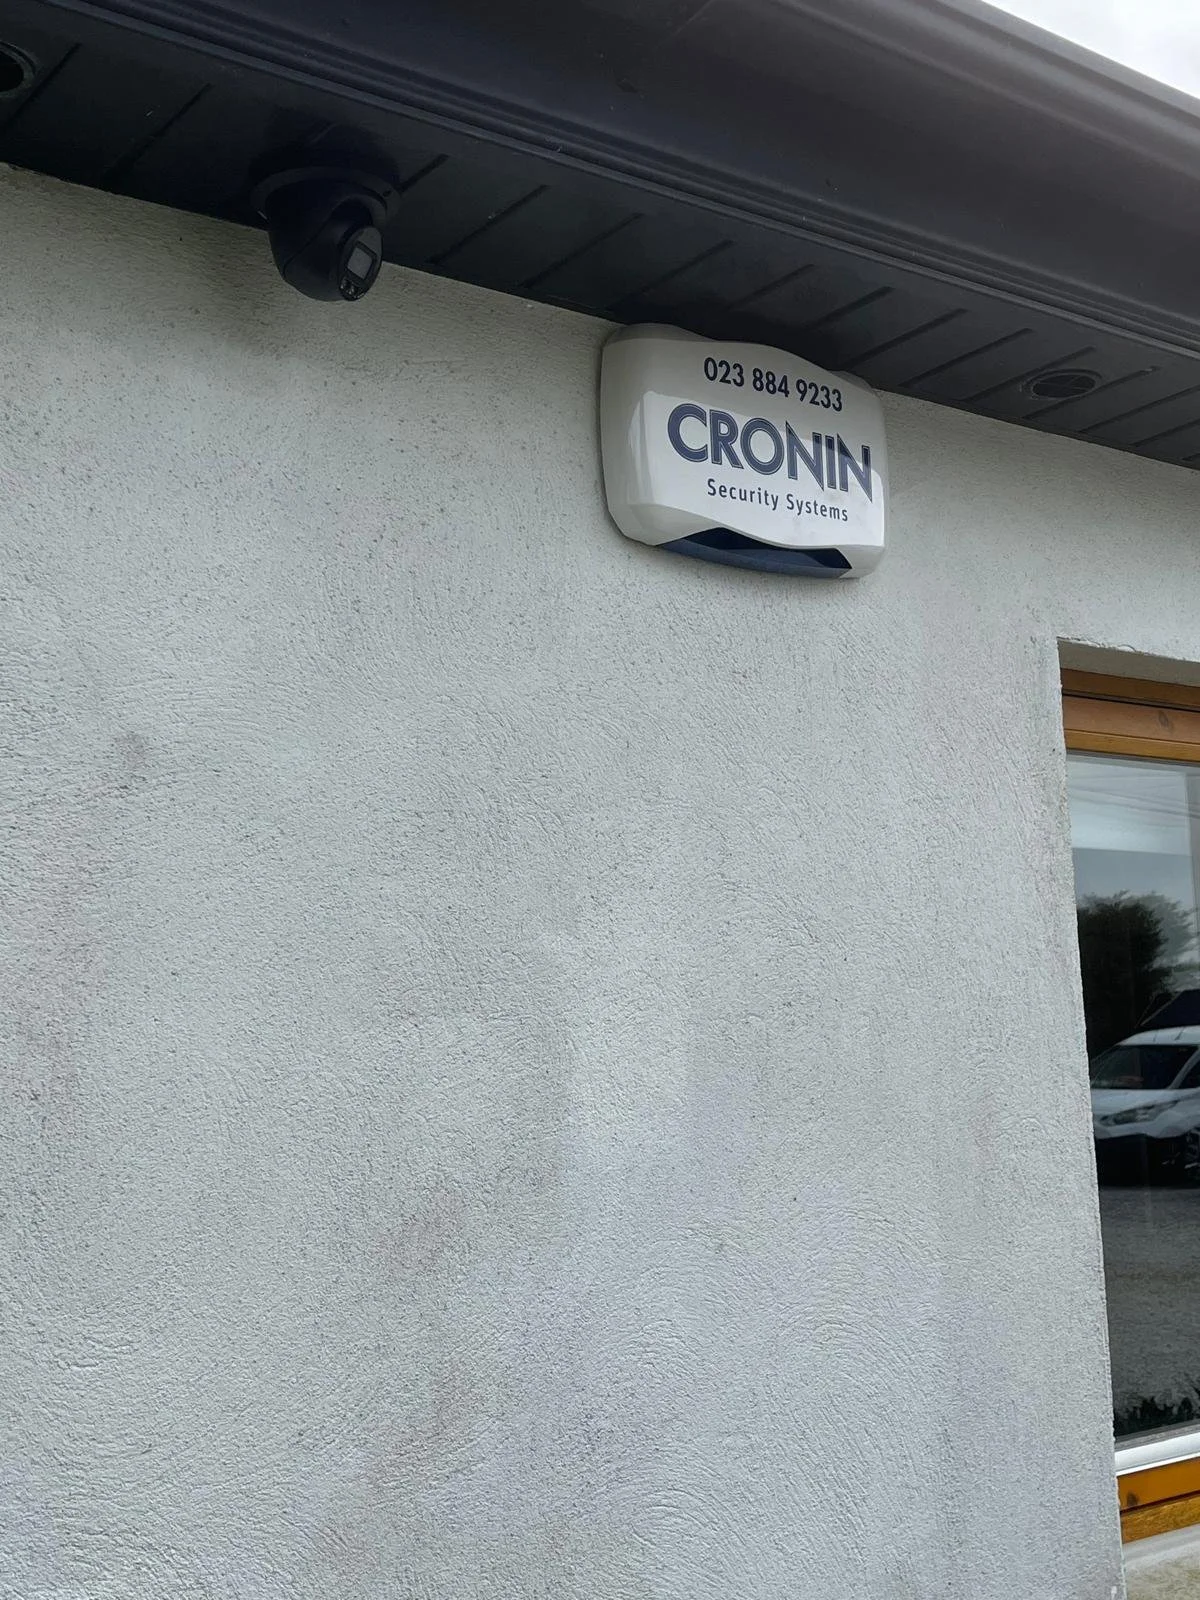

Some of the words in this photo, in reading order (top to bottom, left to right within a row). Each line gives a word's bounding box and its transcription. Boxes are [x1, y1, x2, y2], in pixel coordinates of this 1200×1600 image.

[704, 357, 745, 387] 023
[752, 367, 790, 397] 884
[796, 379, 843, 411] 9233
[667, 403, 873, 503] CRONIN
[707, 478, 779, 510] Security
[786, 494, 848, 522] Systems
